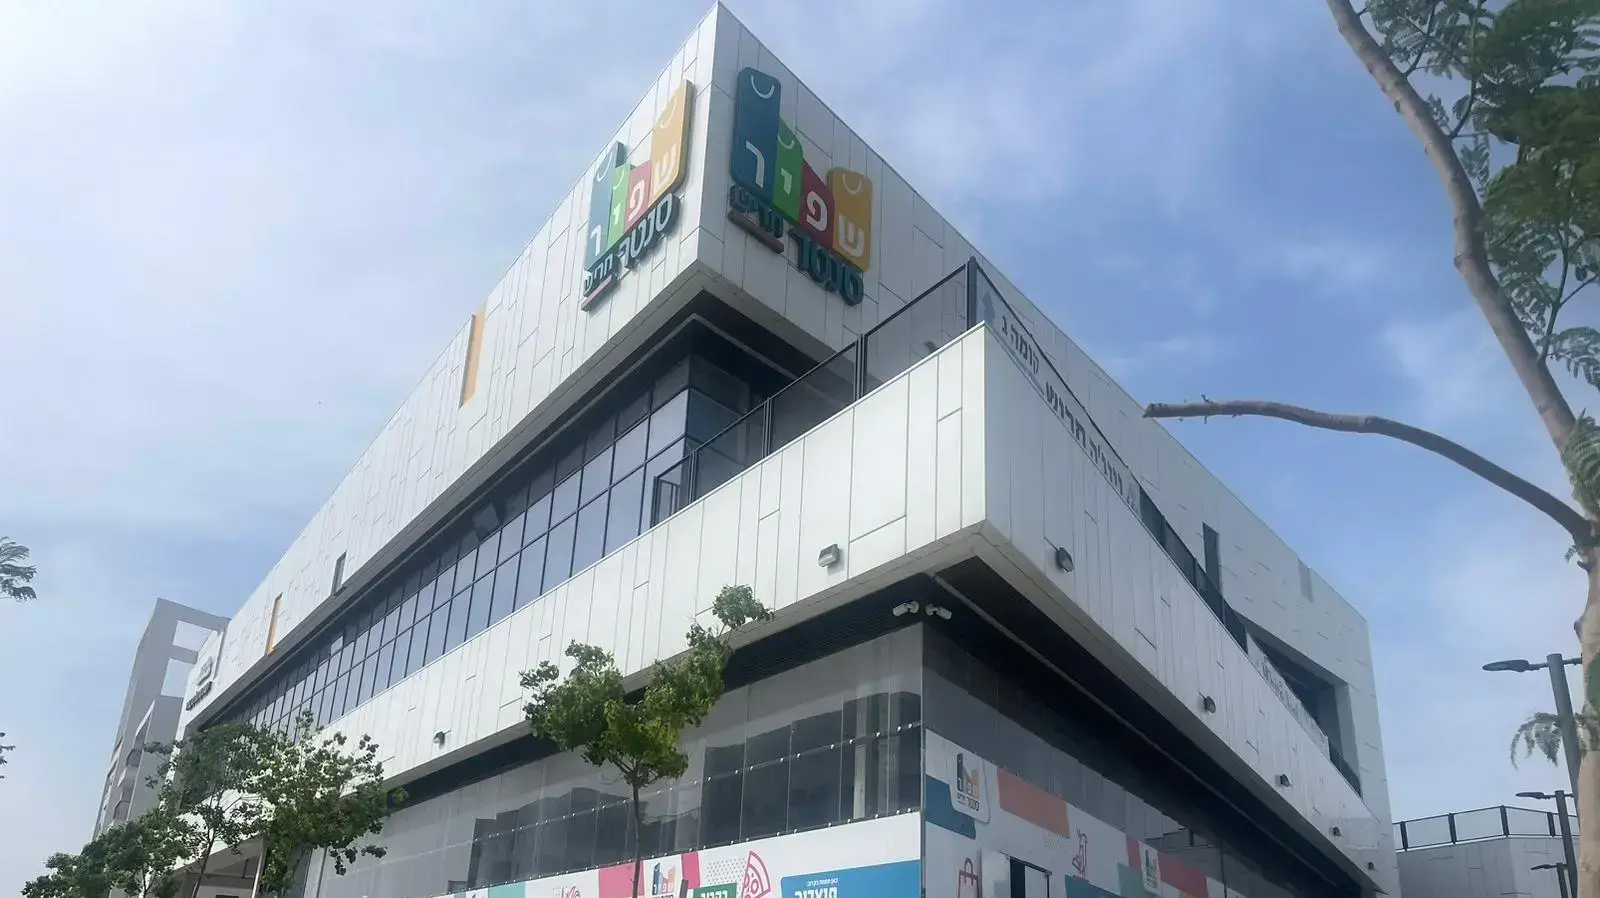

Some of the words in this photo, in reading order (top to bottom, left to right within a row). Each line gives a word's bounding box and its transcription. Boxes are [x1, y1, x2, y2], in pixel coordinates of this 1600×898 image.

[590, 143, 677, 257] שפיר
[618, 192, 679, 268] סנטר
[745, 141, 865, 258] שפיר
[583, 253, 616, 297] חריש
[788, 225, 864, 307] סנטר
[1010, 323, 1040, 375] קומה
